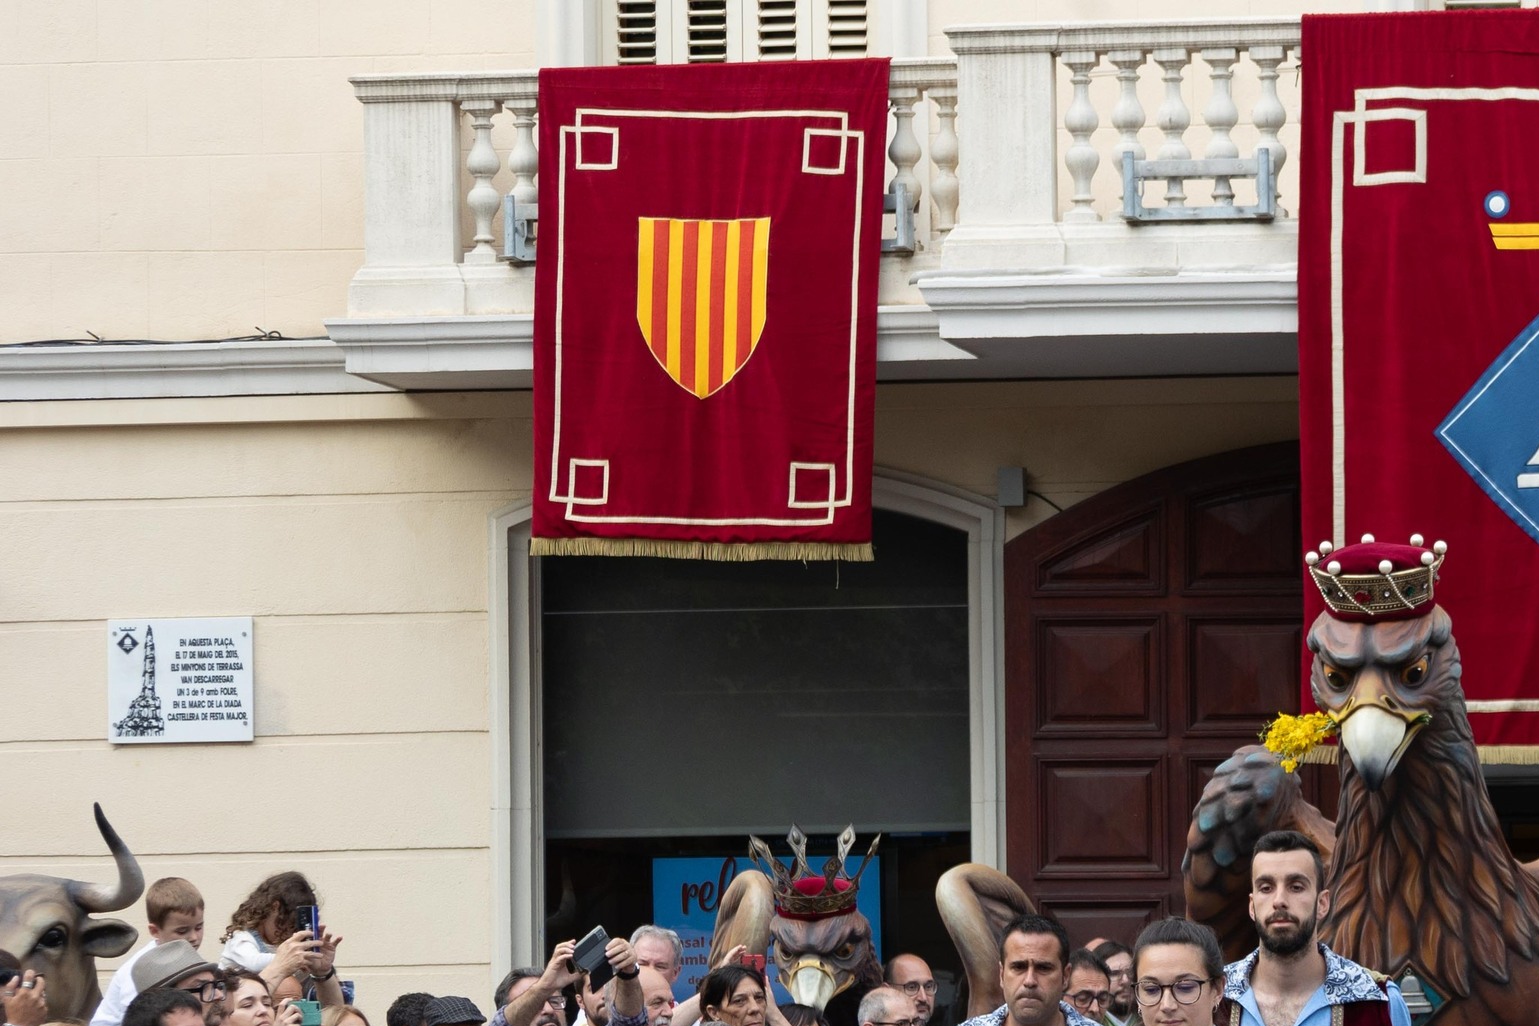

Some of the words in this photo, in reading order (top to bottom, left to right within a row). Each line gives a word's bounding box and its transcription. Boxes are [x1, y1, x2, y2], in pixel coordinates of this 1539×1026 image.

[179, 638, 187, 647] EN
[188, 638, 212, 646] AQUESTA
[214, 638, 234, 649] PLAÇA,
[175, 651, 181, 659] EL
[182, 651, 188, 659] 17
[189, 651, 196, 659] DE
[197, 651, 213, 659] MAIG
[214, 650, 224, 658] DEL
[225, 650, 239, 659] 2015,
[181, 663, 206, 671] MINYONS
[208, 663, 215, 671] DE
[216, 662, 243, 671] TERRASSA
[181, 676, 192, 684] VAN
[194, 675, 234, 683] DESCARREGAR
[177, 688, 185, 696] UN
[191, 688, 199, 696] de
[206, 688, 219, 696] amb
[220, 687, 239, 697] FOLRE,
[188, 700, 206, 708] MARC
[207, 700, 214, 708] DE
[216, 700, 223, 708] LA
[224, 699, 242, 708] DIADA
[167, 713, 199, 721] CASTELLERA
